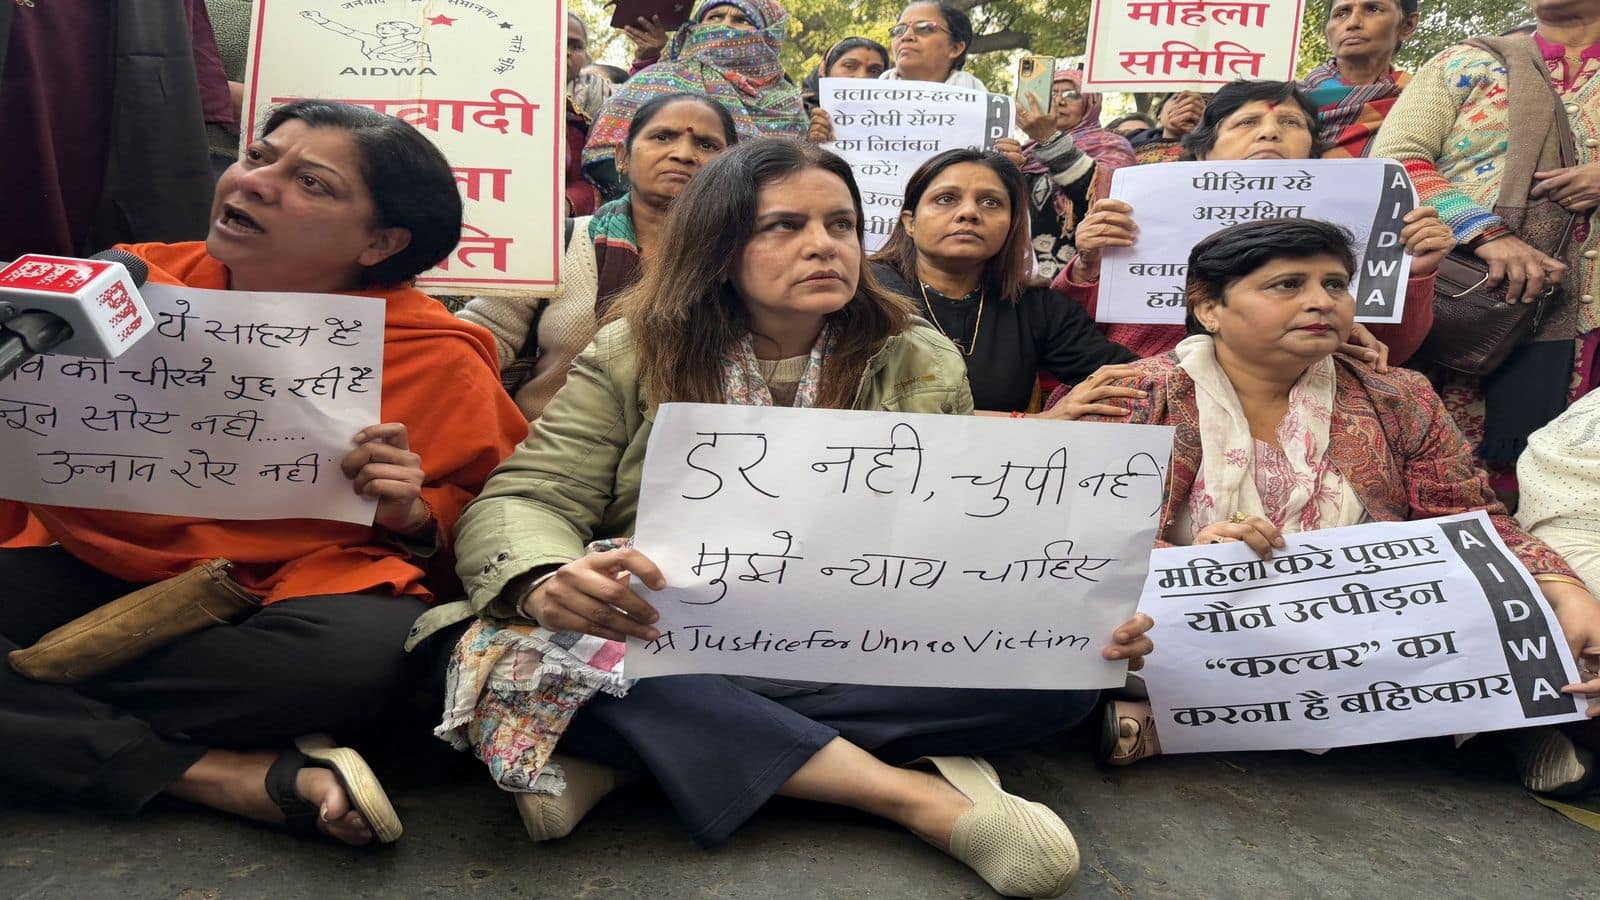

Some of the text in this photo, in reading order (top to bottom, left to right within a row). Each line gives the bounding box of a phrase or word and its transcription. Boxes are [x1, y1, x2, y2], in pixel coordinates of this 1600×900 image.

[339, 66, 438, 77] AIDWA
[1119, 40, 1266, 78] समिति
[833, 88, 976, 102] बलात्कार-हत्या
[833, 109, 957, 127] के दोषी सेंगर
[835, 135, 941, 152] का निलंबन
[1192, 170, 1315, 194] पीड़िता रहे
[1192, 200, 1306, 226] असुरक्षित
[1364, 173, 1407, 306] AIDWA
[157, 299, 200, 341] ये
[205, 320, 319, 347] साहस
[288, 366, 344, 399] रही
[681, 432, 780, 500] डर
[951, 447, 1067, 518] चुपी
[680, 530, 1120, 605] मुझे न्याय चाहिए
[1154, 535, 1440, 589] महिला करे पुकार
[1184, 579, 1448, 633] यौन उत्पीड़न
[1458, 529, 1561, 702] AIDWA
[1392, 630, 1459, 659] का
[1170, 673, 1513, 727] करना है बहिष्कार
